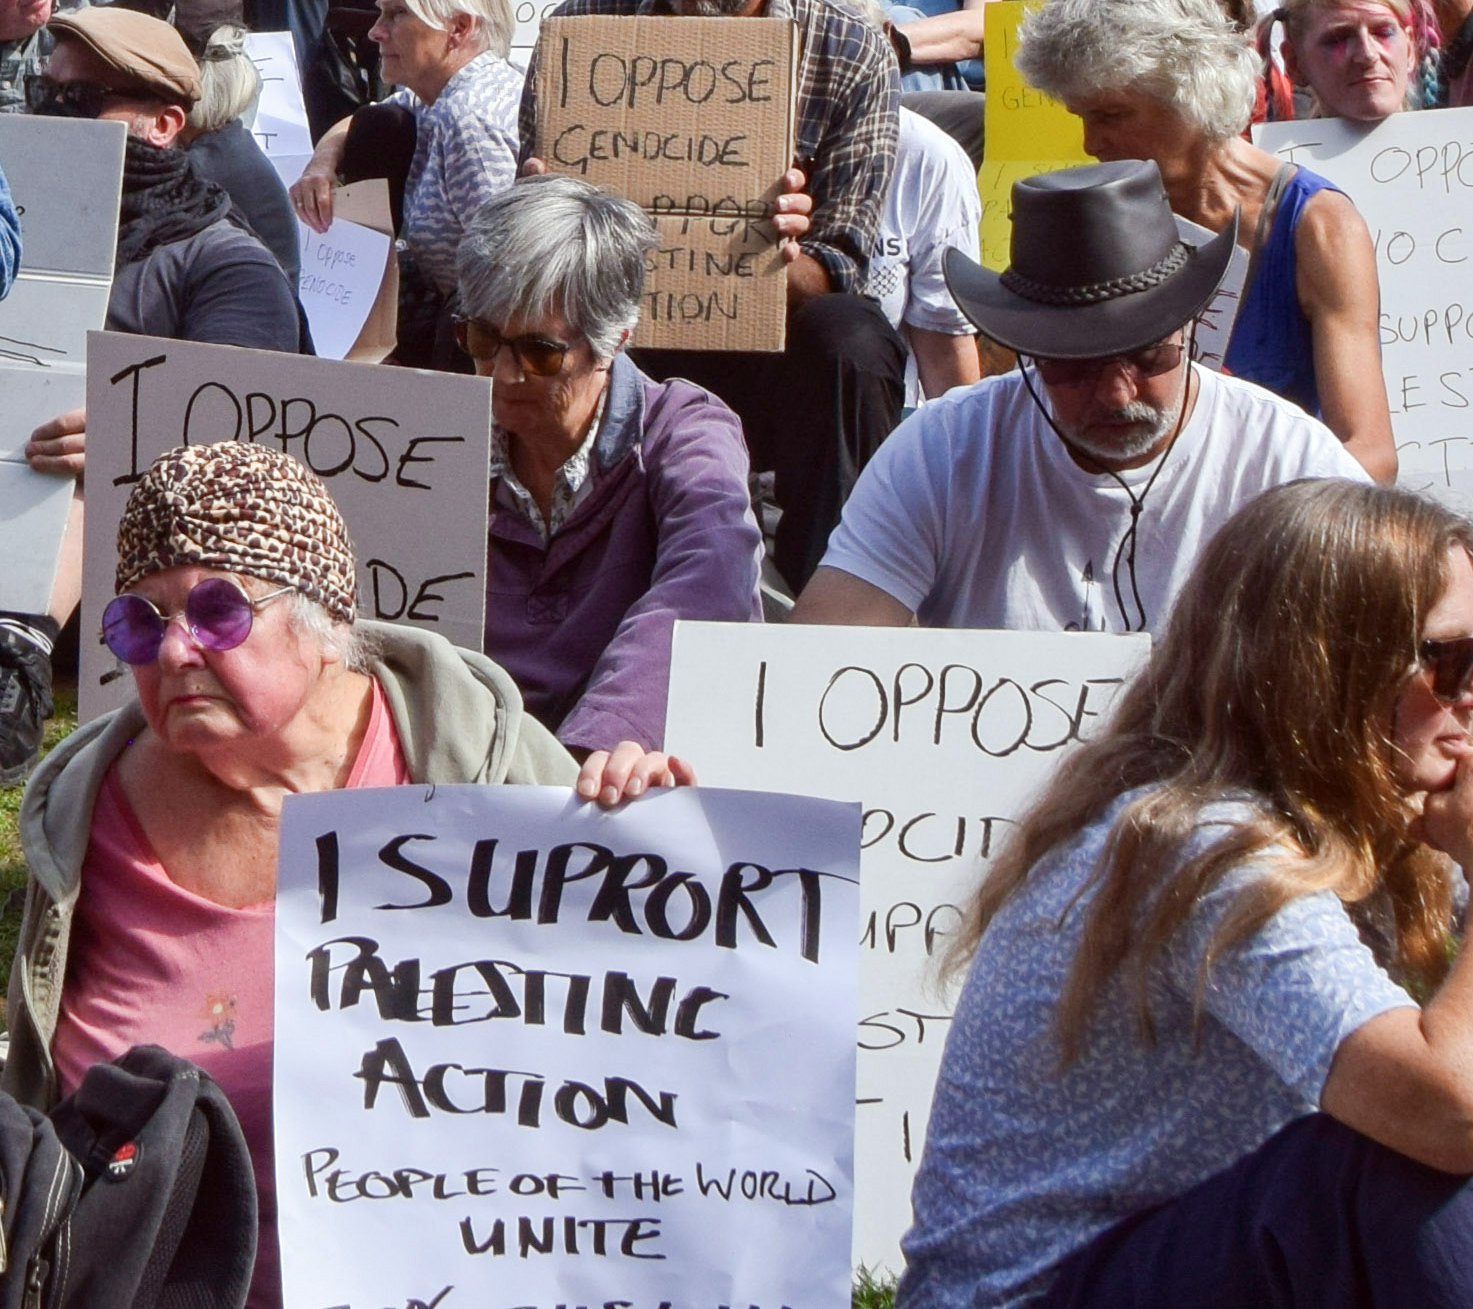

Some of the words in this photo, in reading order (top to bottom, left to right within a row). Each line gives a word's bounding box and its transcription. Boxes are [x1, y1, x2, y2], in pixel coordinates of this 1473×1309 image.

[559, 36, 569, 110] I
[588, 55, 778, 109] OPPOSE
[554, 120, 750, 180] GENOCIDE
[645, 290, 740, 322] TION
[110, 354, 167, 487] I
[183, 382, 466, 491] OPPOSE
[755, 659, 768, 747] I
[314, 831, 339, 924] I
[373, 831, 860, 964] SUPPORT
[351, 1037, 678, 1131] ACTION
[300, 1146, 500, 1203] PEOPLE
[508, 1172, 588, 1200] OF
[695, 1161, 837, 1206] WORLD
[459, 1215, 667, 1260] UNITE
